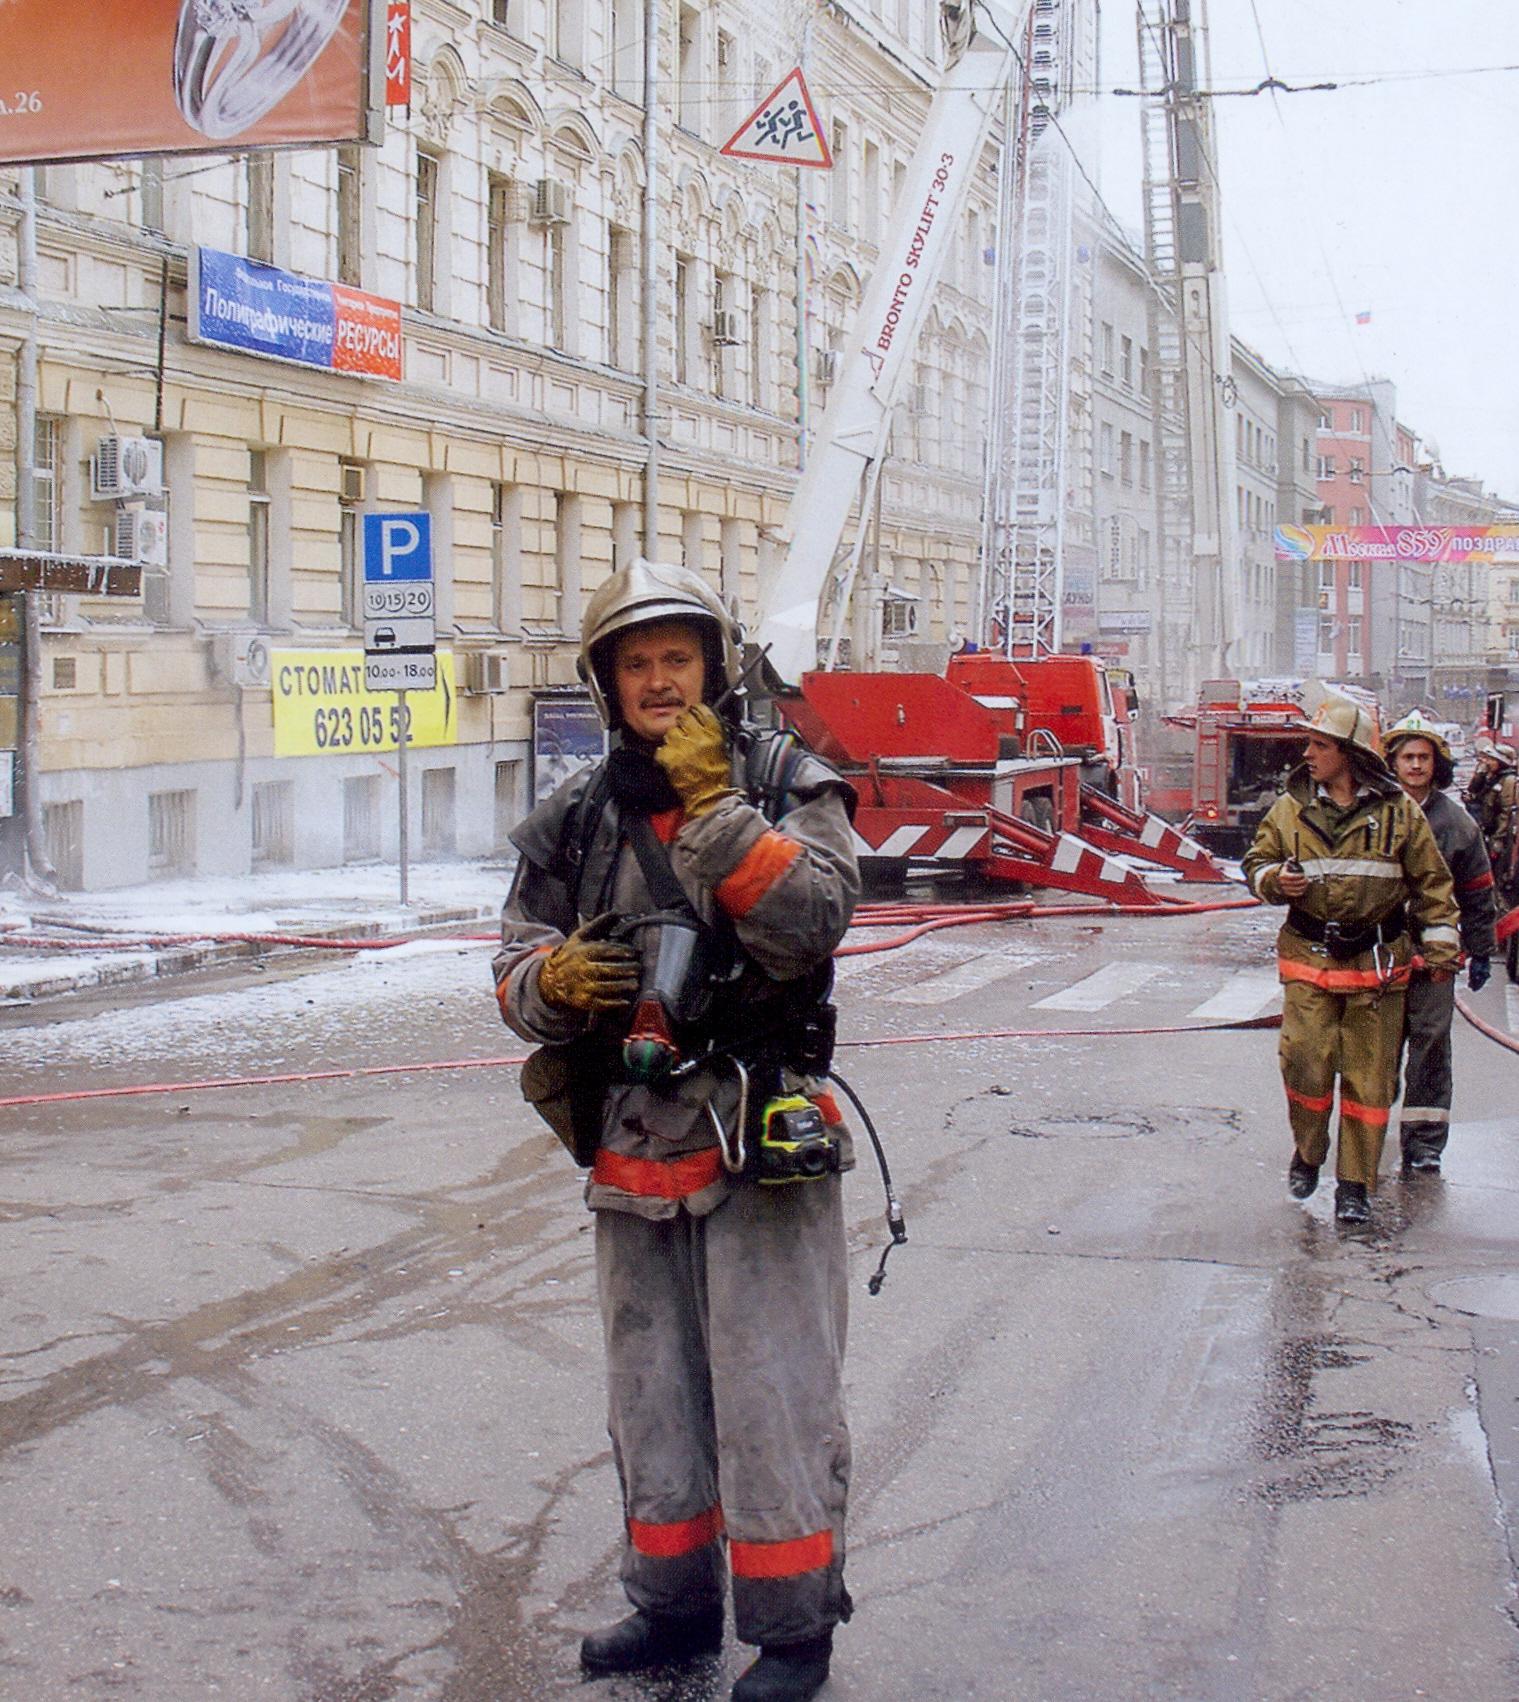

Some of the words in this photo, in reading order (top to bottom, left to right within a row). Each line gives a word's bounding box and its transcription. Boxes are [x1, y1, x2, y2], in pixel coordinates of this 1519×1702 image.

[877, 272, 912, 351] BRONTO
[906, 194, 939, 268] SKYLIFT
[205, 287, 332, 345] Полиграфические
[337, 319, 398, 358] РЕСУРСЫ
[382, 520, 420, 574] P
[1397, 529, 1444, 557] 859
[370, 594, 382, 605] 10
[388, 593, 401, 605] 15
[407, 592, 427, 605] 20
[280, 666, 362, 696] СТОМАТ
[315, 706, 353, 748] 623
[360, 706, 382, 745] 05
[390, 704, 413, 744] 52
